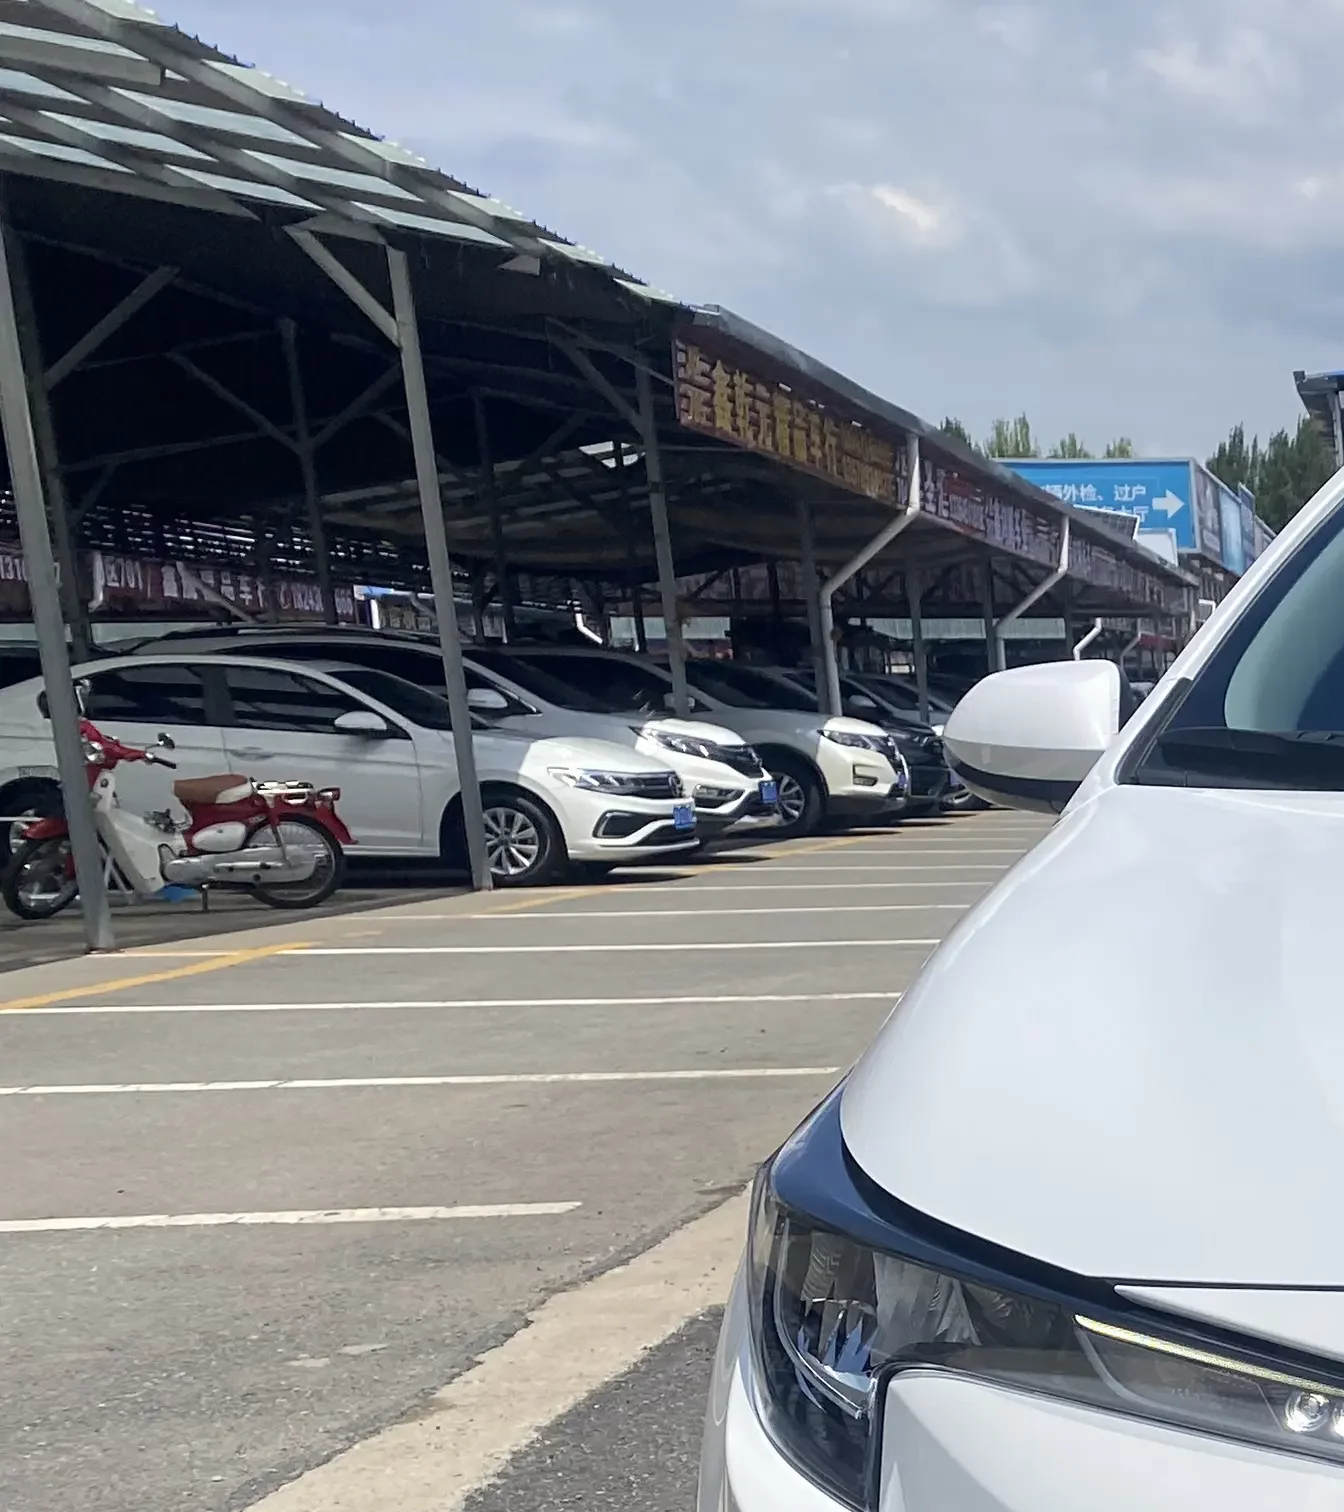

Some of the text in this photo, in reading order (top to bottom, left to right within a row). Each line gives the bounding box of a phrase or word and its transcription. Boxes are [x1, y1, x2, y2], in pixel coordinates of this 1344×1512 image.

[1040, 484, 1147, 502] 辆外检、过户
